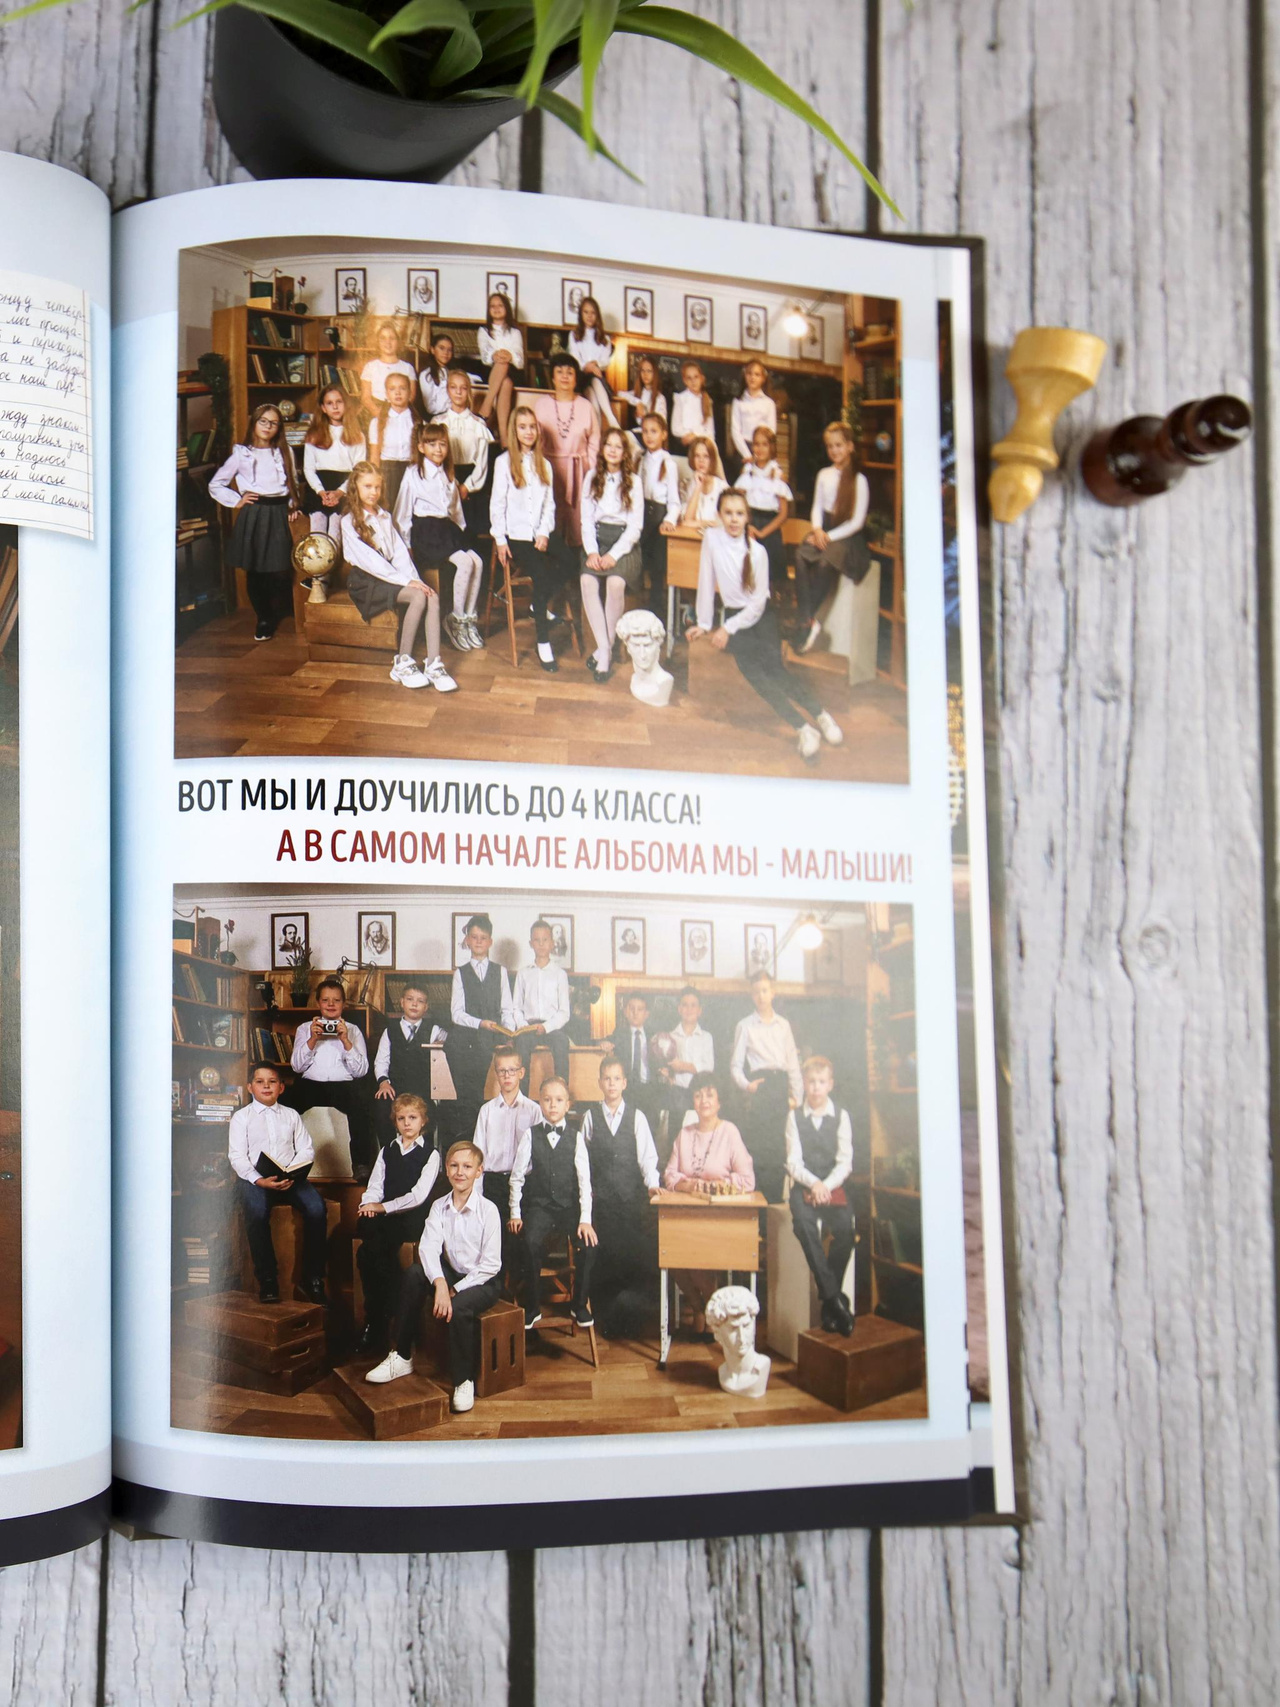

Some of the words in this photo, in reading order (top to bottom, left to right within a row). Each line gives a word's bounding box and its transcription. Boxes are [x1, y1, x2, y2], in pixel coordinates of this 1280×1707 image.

[6, 315, 31, 327] мы
[12, 333, 22, 344] и
[20, 355, 35, 366] не
[1, 409, 29, 429] жду
[28, 471, 66, 486] школе
[2, 483, 12, 499] в
[15, 489, 45, 503] моей
[178, 779, 233, 812] ВОТ
[241, 778, 296, 811] МЫ
[306, 778, 326, 811] И
[333, 778, 520, 817] ДОУЧИЛИСЬ
[525, 784, 565, 823] ДО
[571, 788, 588, 819] 4
[594, 788, 702, 826] КЛАССА!
[276, 829, 297, 862] А
[304, 829, 323, 862] В
[330, 829, 446, 865] САМОМ
[455, 832, 568, 870] НАЧАЛЕ
[573, 837, 707, 875] АЛЬБОМА
[713, 844, 758, 877] МЫ
[781, 847, 913, 884] МАЛЫШИ!
